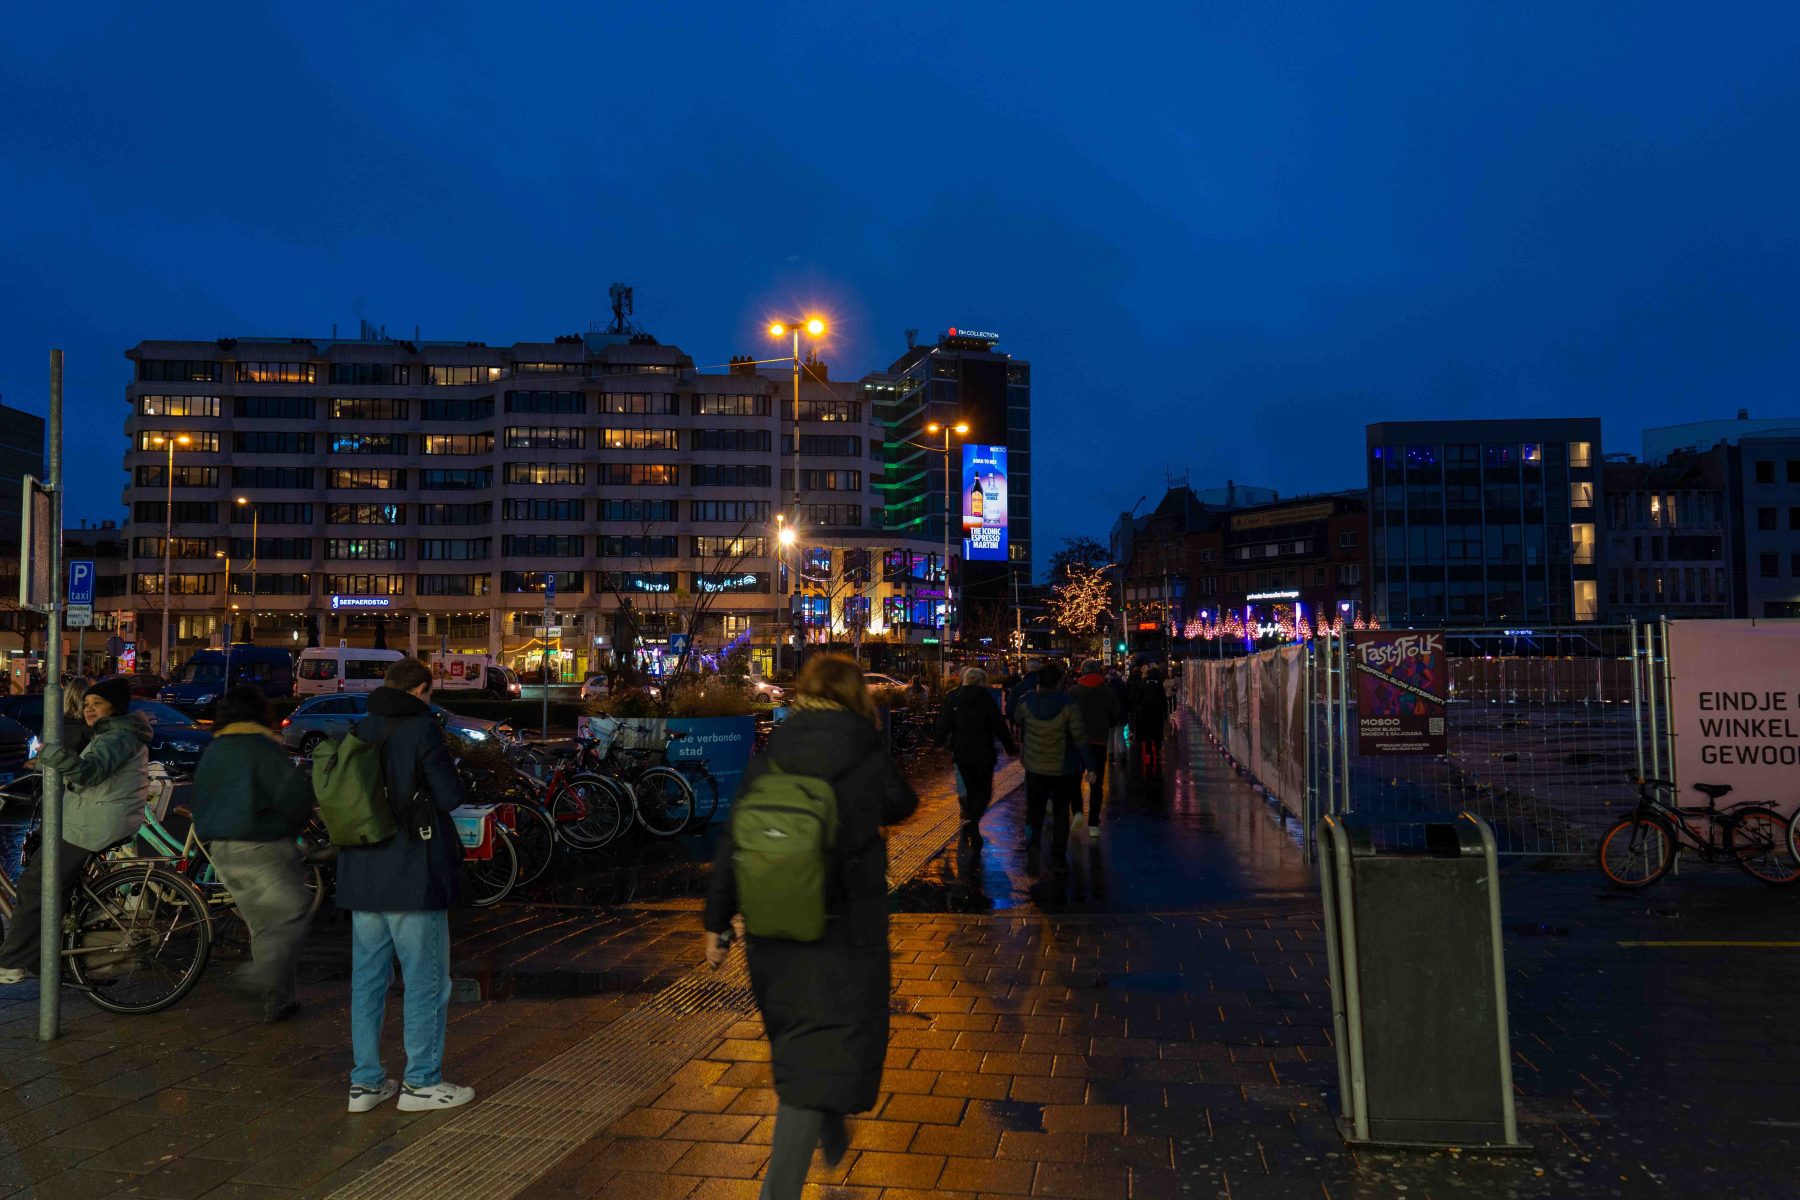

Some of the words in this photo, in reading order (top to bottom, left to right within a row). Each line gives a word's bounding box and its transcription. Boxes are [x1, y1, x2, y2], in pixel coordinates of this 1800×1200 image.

[967, 330, 999, 338] COLLECTION
[982, 527, 1001, 535] ICONIC
[973, 541, 999, 549] MARTINI
[74, 564, 88, 586] P
[548, 574, 554, 588] P
[71, 590, 89, 600] taxi
[1356, 662, 1390, 681] UNOFFICIAL
[1389, 677, 1409, 689] GLOW
[1408, 685, 1446, 705] AFTERPARTY
[1699, 691, 1787, 711] EINDJE
[1361, 718, 1400, 726] MOSOO
[1699, 718, 1799, 737] WINKEL
[696, 732, 742, 743] verbonden
[679, 745, 703, 756] stad
